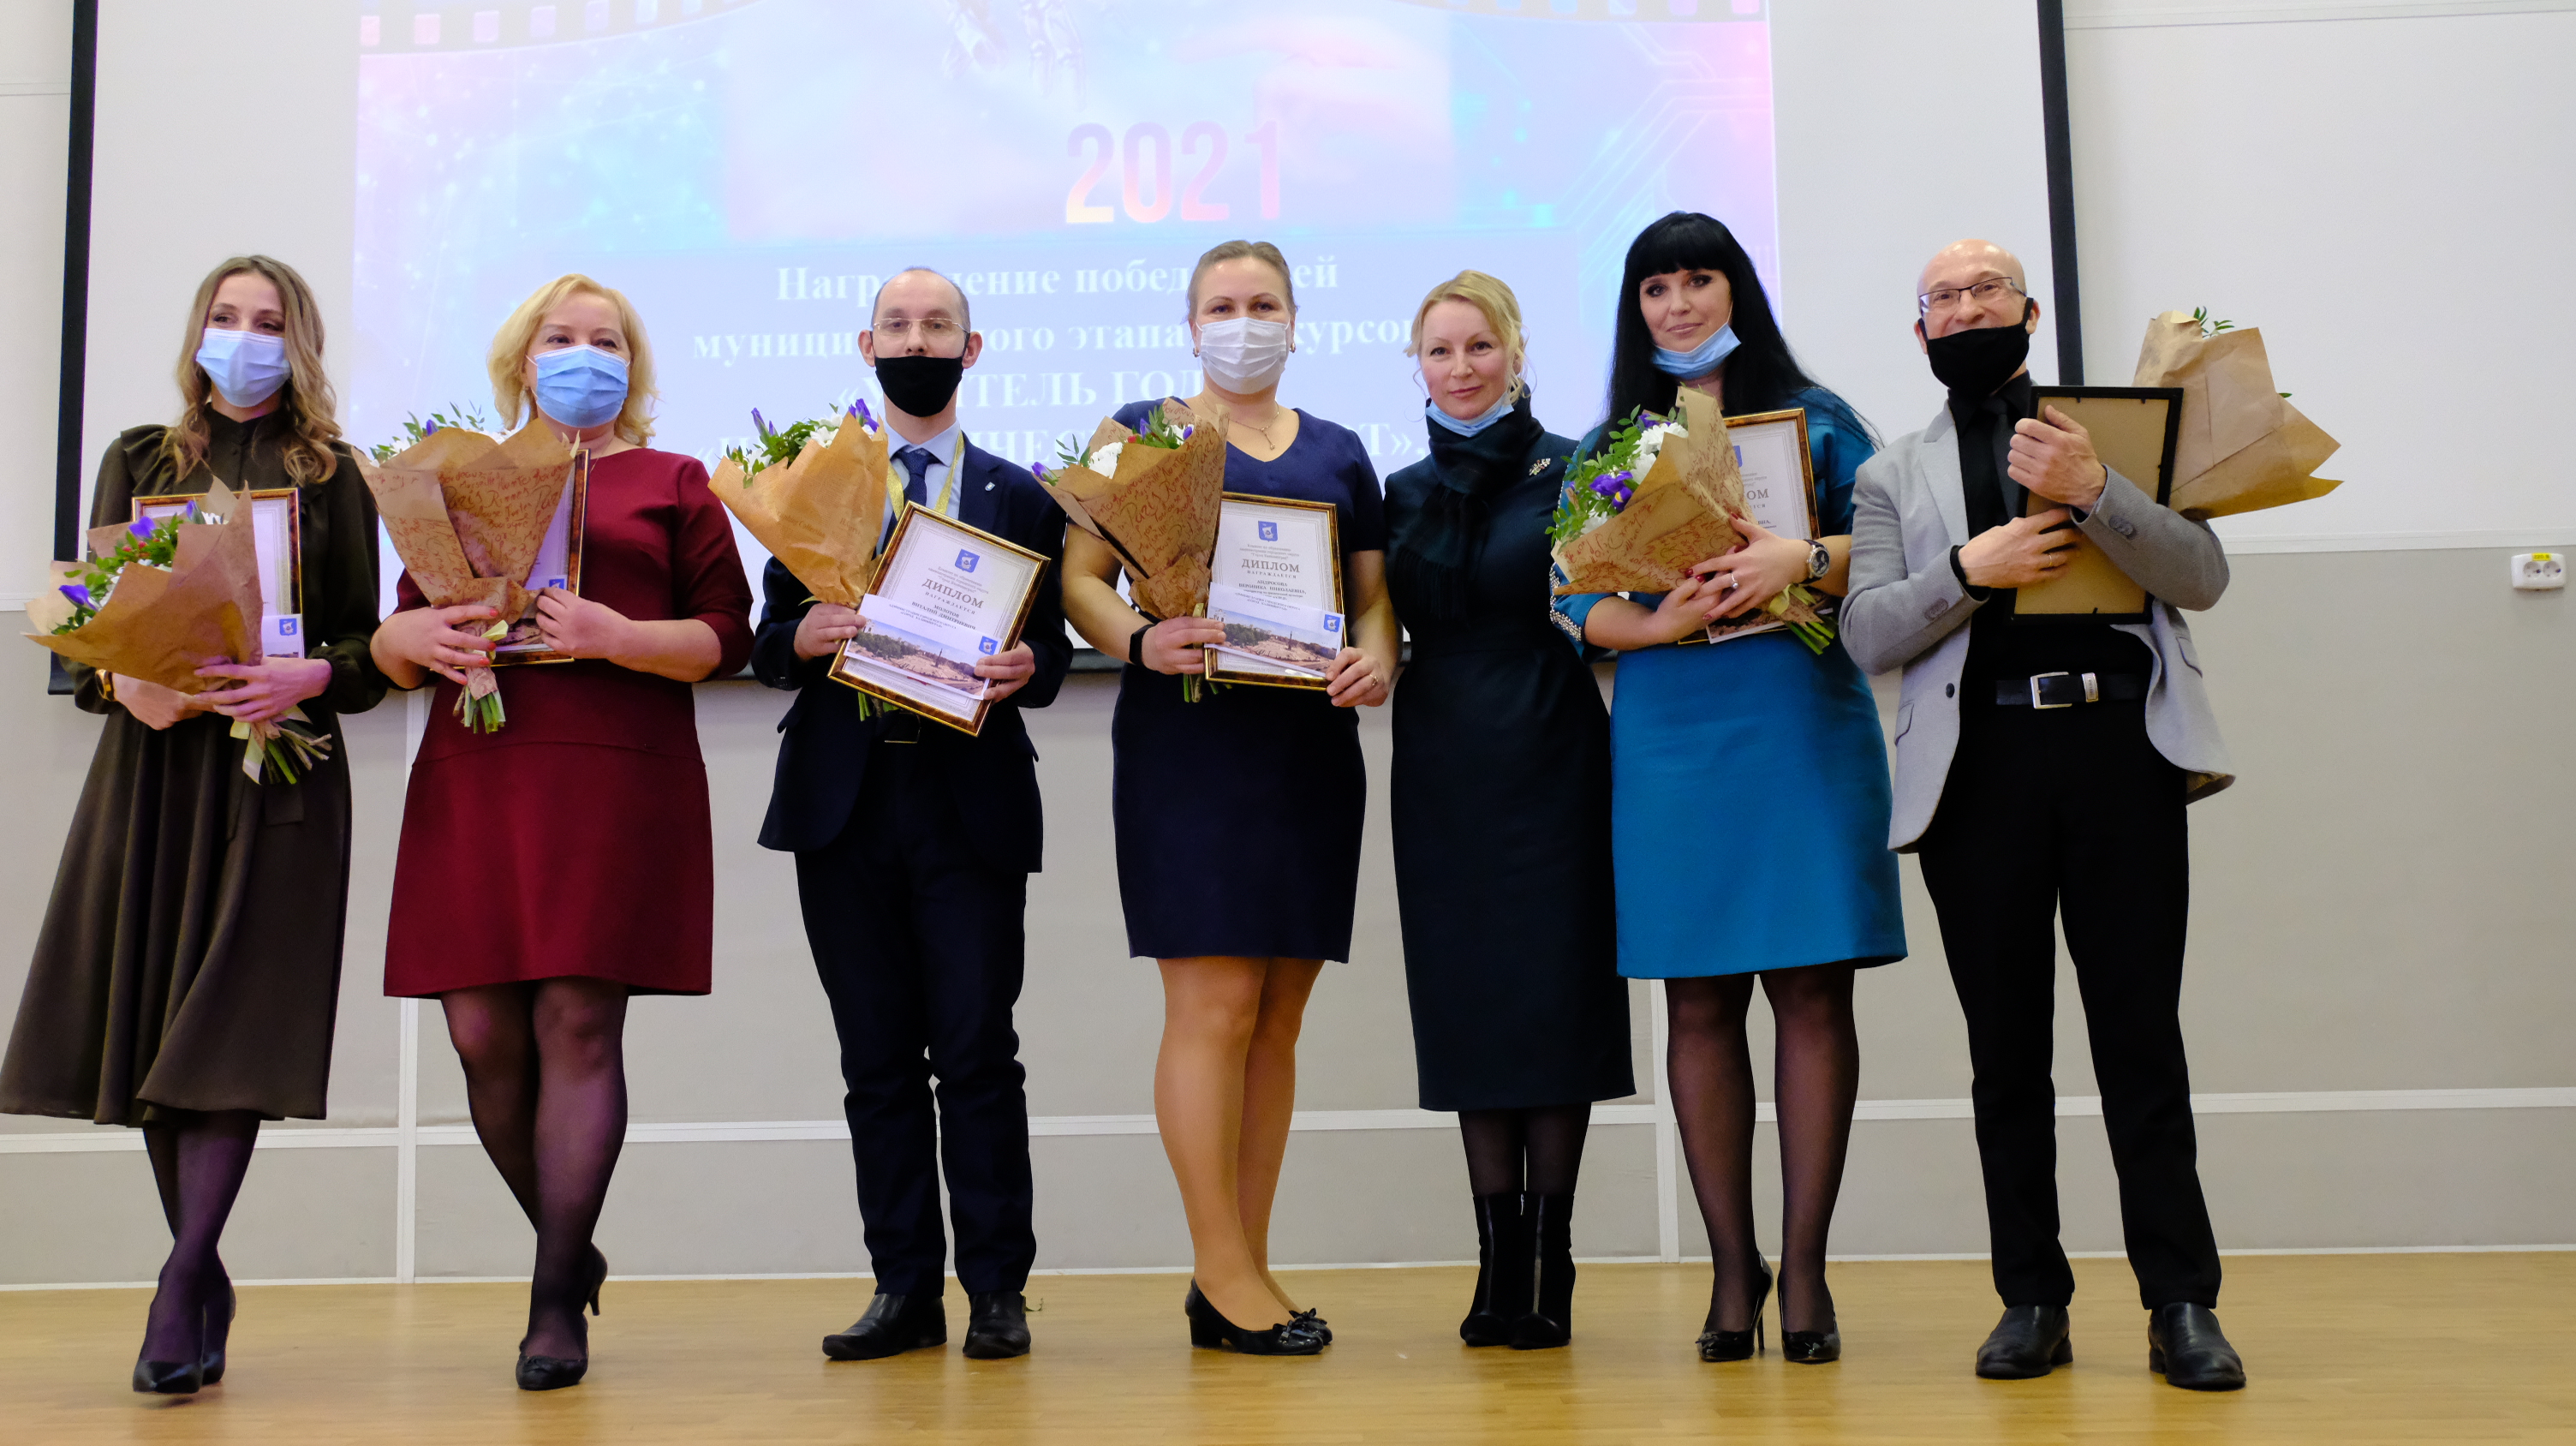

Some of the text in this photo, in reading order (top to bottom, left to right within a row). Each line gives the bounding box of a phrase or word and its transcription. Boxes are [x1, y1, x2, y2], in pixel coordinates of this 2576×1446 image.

[1066, 119, 1280, 224] 2021
[776, 255, 1338, 308] Нагрение победей
[694, 326, 1055, 367] мунициого
[1068, 323, 1185, 351] этапа
[1241, 558, 1300, 573] ДИПЛОМ
[1247, 570, 1297, 579] НАГРАЖДАЕТСЯ
[921, 577, 985, 609] ДИПЛОМ
